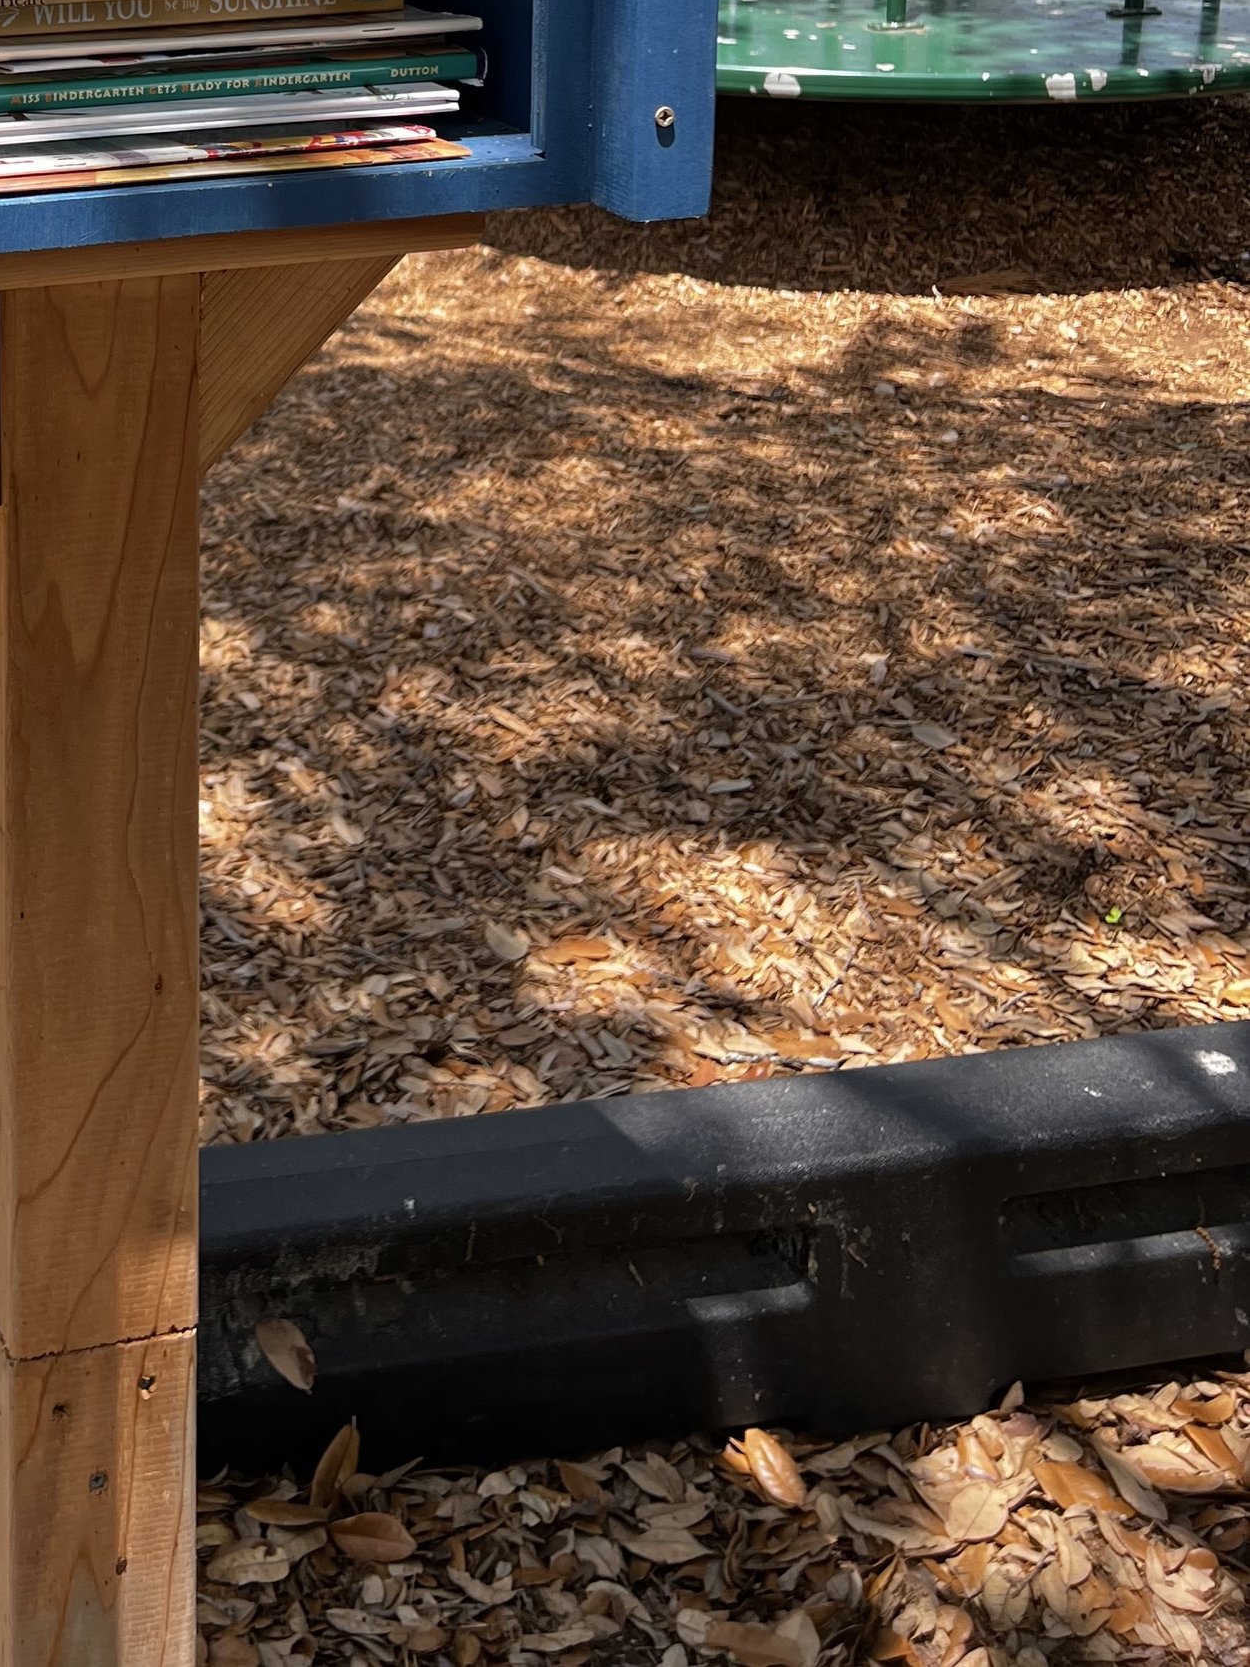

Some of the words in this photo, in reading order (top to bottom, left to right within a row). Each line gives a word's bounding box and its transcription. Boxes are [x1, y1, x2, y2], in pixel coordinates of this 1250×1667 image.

[34, 1, 95, 26] WILL
[103, 0, 153, 21] YOU
[10, 93, 41, 105] MISS
[45, 86, 145, 103] BINDERGARTEN
[149, 83, 178, 95] GETS
[181, 80, 222, 93] READY
[226, 77, 250, 89] FOR
[253, 70, 352, 87] KINDERGARTEN
[390, 65, 440, 78] DUTTON
